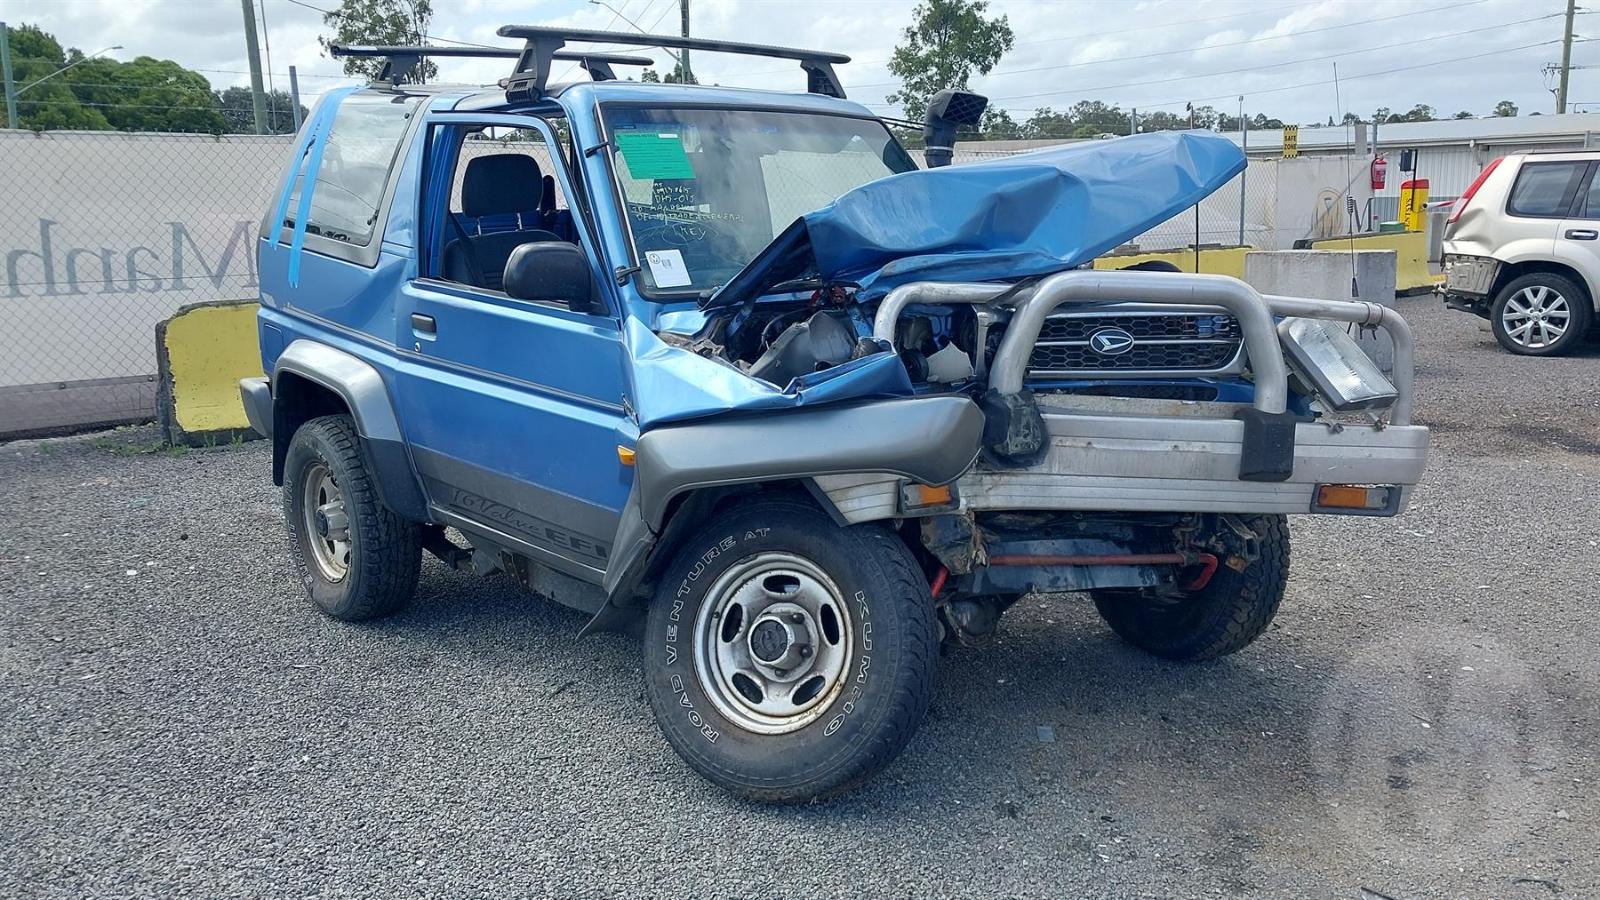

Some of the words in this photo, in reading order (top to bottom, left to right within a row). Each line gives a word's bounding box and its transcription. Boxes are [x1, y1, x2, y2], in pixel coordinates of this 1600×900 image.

[544, 527, 608, 558] EFI
[744, 527, 771, 542] AT
[666, 535, 737, 665] VENTURE
[823, 590, 873, 737] KUMHO
[670, 674, 720, 743] ROAD
